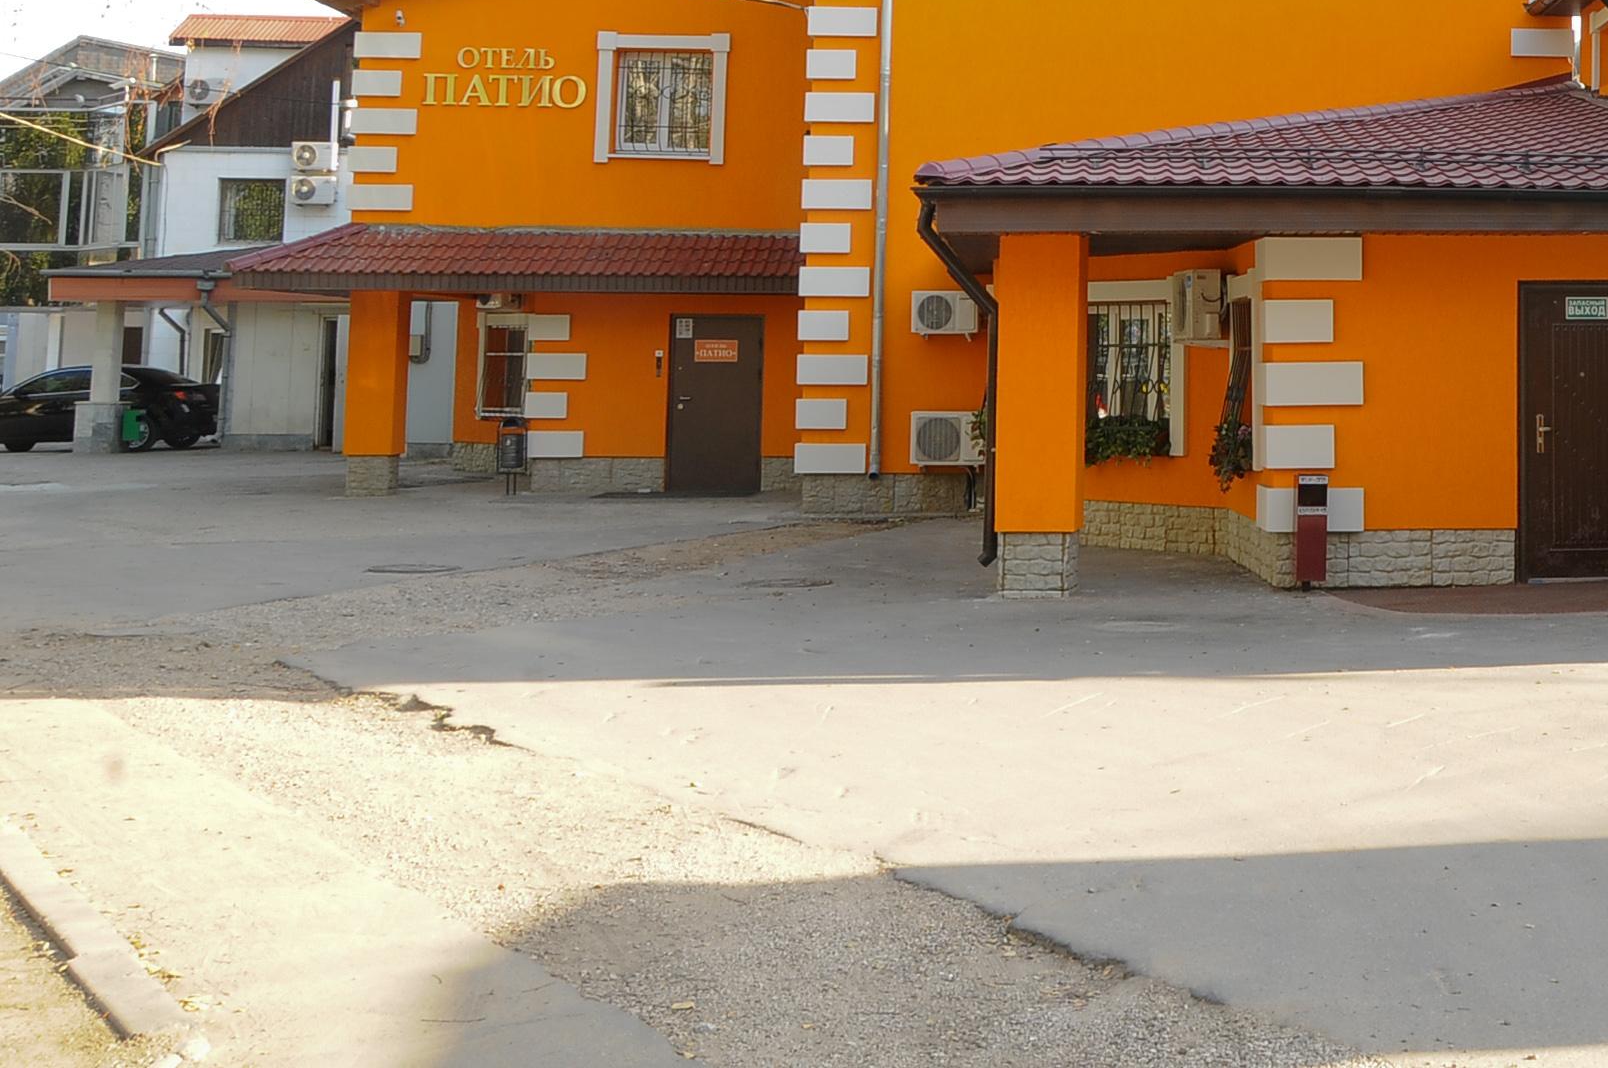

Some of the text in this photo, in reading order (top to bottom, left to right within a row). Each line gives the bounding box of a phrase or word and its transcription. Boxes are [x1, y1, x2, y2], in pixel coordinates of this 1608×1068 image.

[457, 46, 555, 69] ОТЕЛЬ
[422, 73, 587, 108] ПАТИО
[1568, 306, 1606, 317] ВЫХОД
